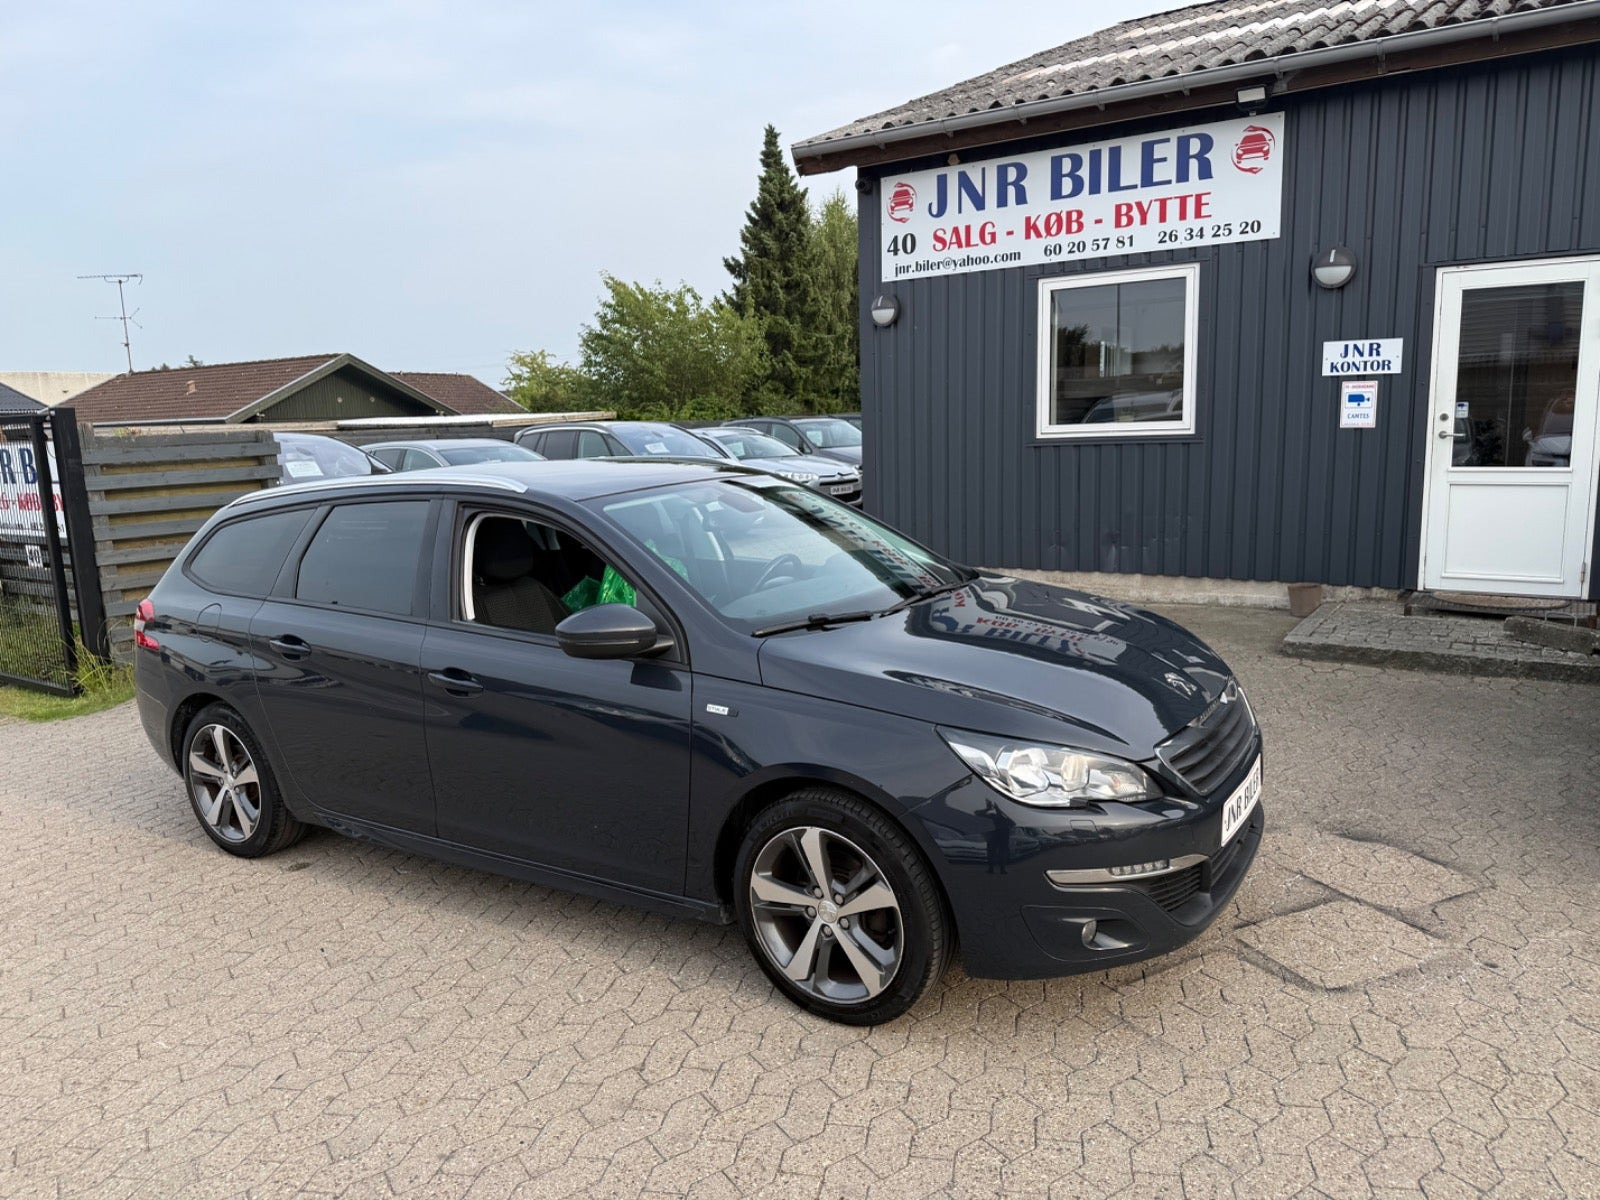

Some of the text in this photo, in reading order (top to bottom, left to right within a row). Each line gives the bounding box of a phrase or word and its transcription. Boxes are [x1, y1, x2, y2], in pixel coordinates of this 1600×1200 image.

[928, 132, 1215, 219] JNR BILER
[932, 221, 997, 252] SALG
[1024, 208, 1085, 241] KØB
[1114, 192, 1212, 229] BYTTE
[1157, 219, 1261, 244] 26 34 25 20
[887, 232, 917, 257] 40
[1043, 234, 1134, 257] 60 20 57 81
[895, 251, 1022, 278] jnr.biler@yahoo.com
[1340, 342, 1382, 359] JNR
[1330, 360, 1391, 373] KONTOR
